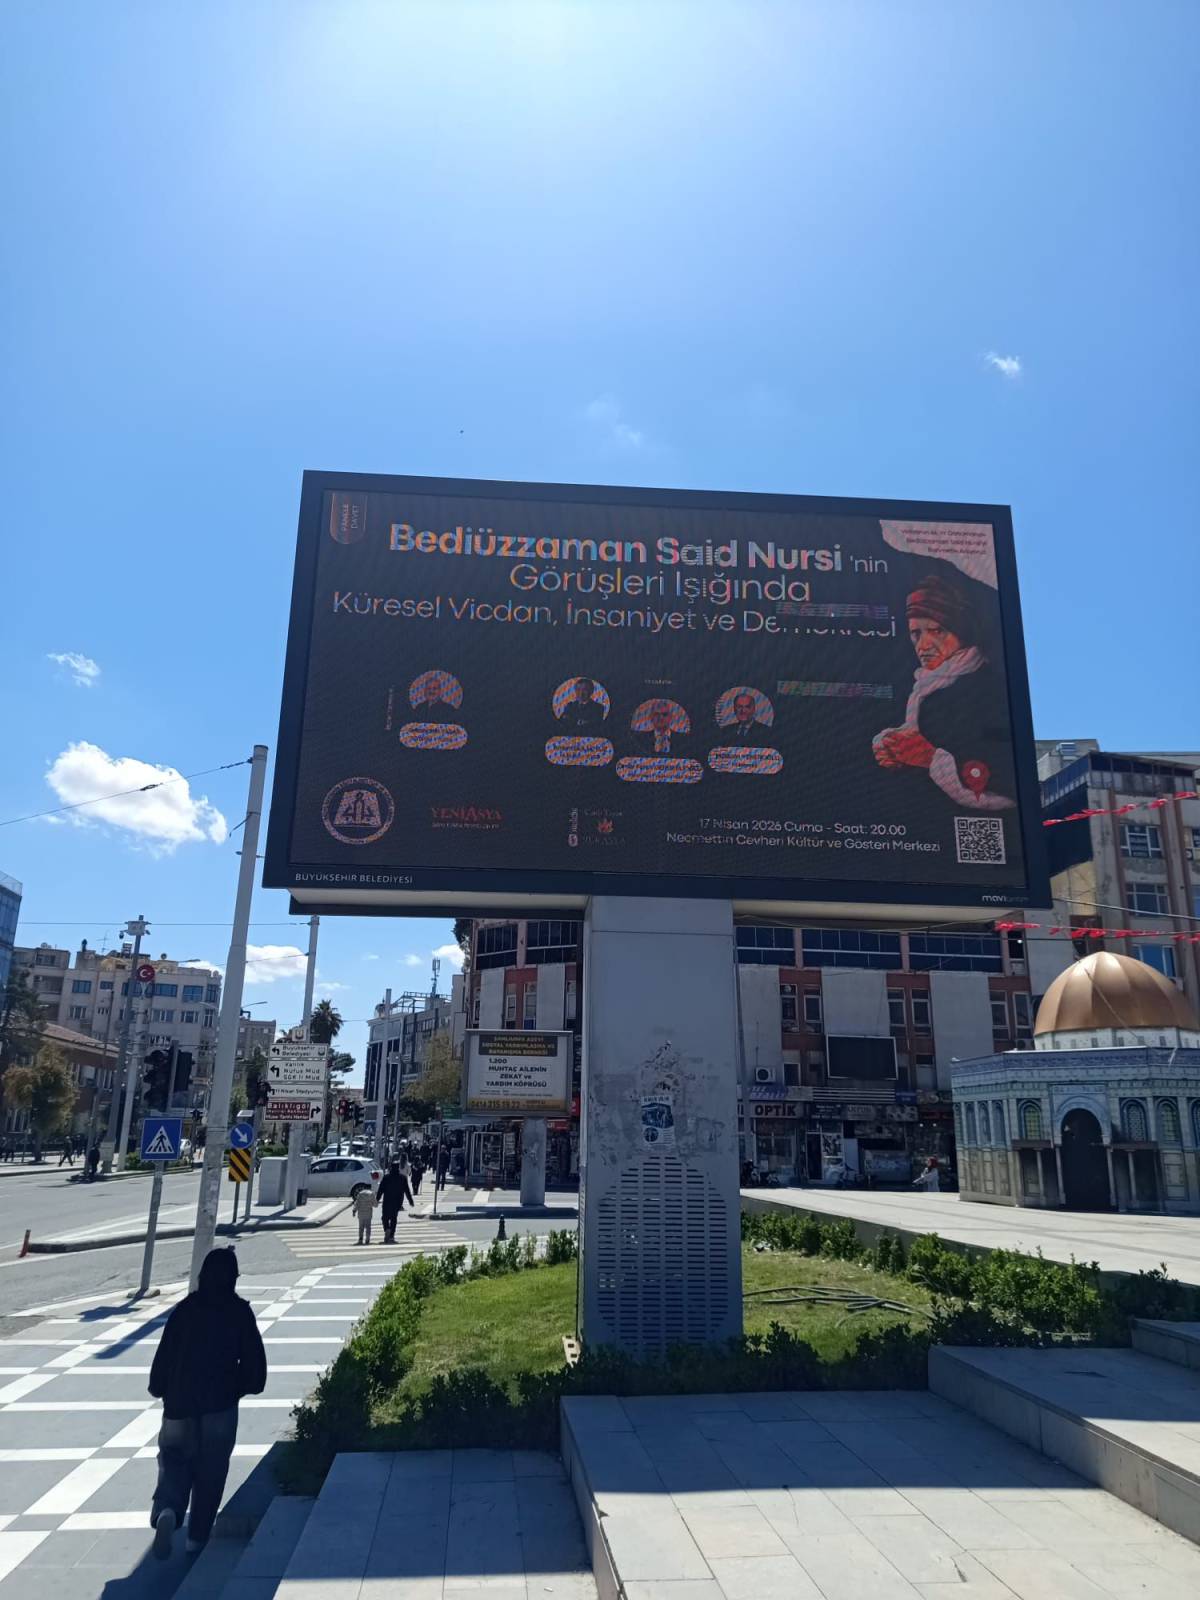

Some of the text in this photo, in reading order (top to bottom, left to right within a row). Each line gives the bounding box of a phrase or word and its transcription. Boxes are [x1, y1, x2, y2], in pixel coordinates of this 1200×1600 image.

[389, 523, 888, 574] Bediüzzaman Said Nursi 'nin
[510, 563, 811, 605] Görüşleri Işığında
[332, 591, 441, 618] Küresel
[448, 597, 558, 626] Vicdan,
[566, 598, 697, 633] İnsaniyet
[702, 612, 736, 631] ve
[699, 817, 710, 829] 17
[712, 818, 749, 831] Nisan
[751, 819, 782, 832] 2026
[784, 820, 824, 833] Cuma
[834, 822, 868, 835] Saat:
[870, 823, 907, 836] 20.00
[665, 831, 942, 853] Necmettin Cevheri Kültür ve Gösteri Merkezi
[359, 873, 413, 885] BELEDİYESİ
[755, 1104, 796, 1116] OPTİK
